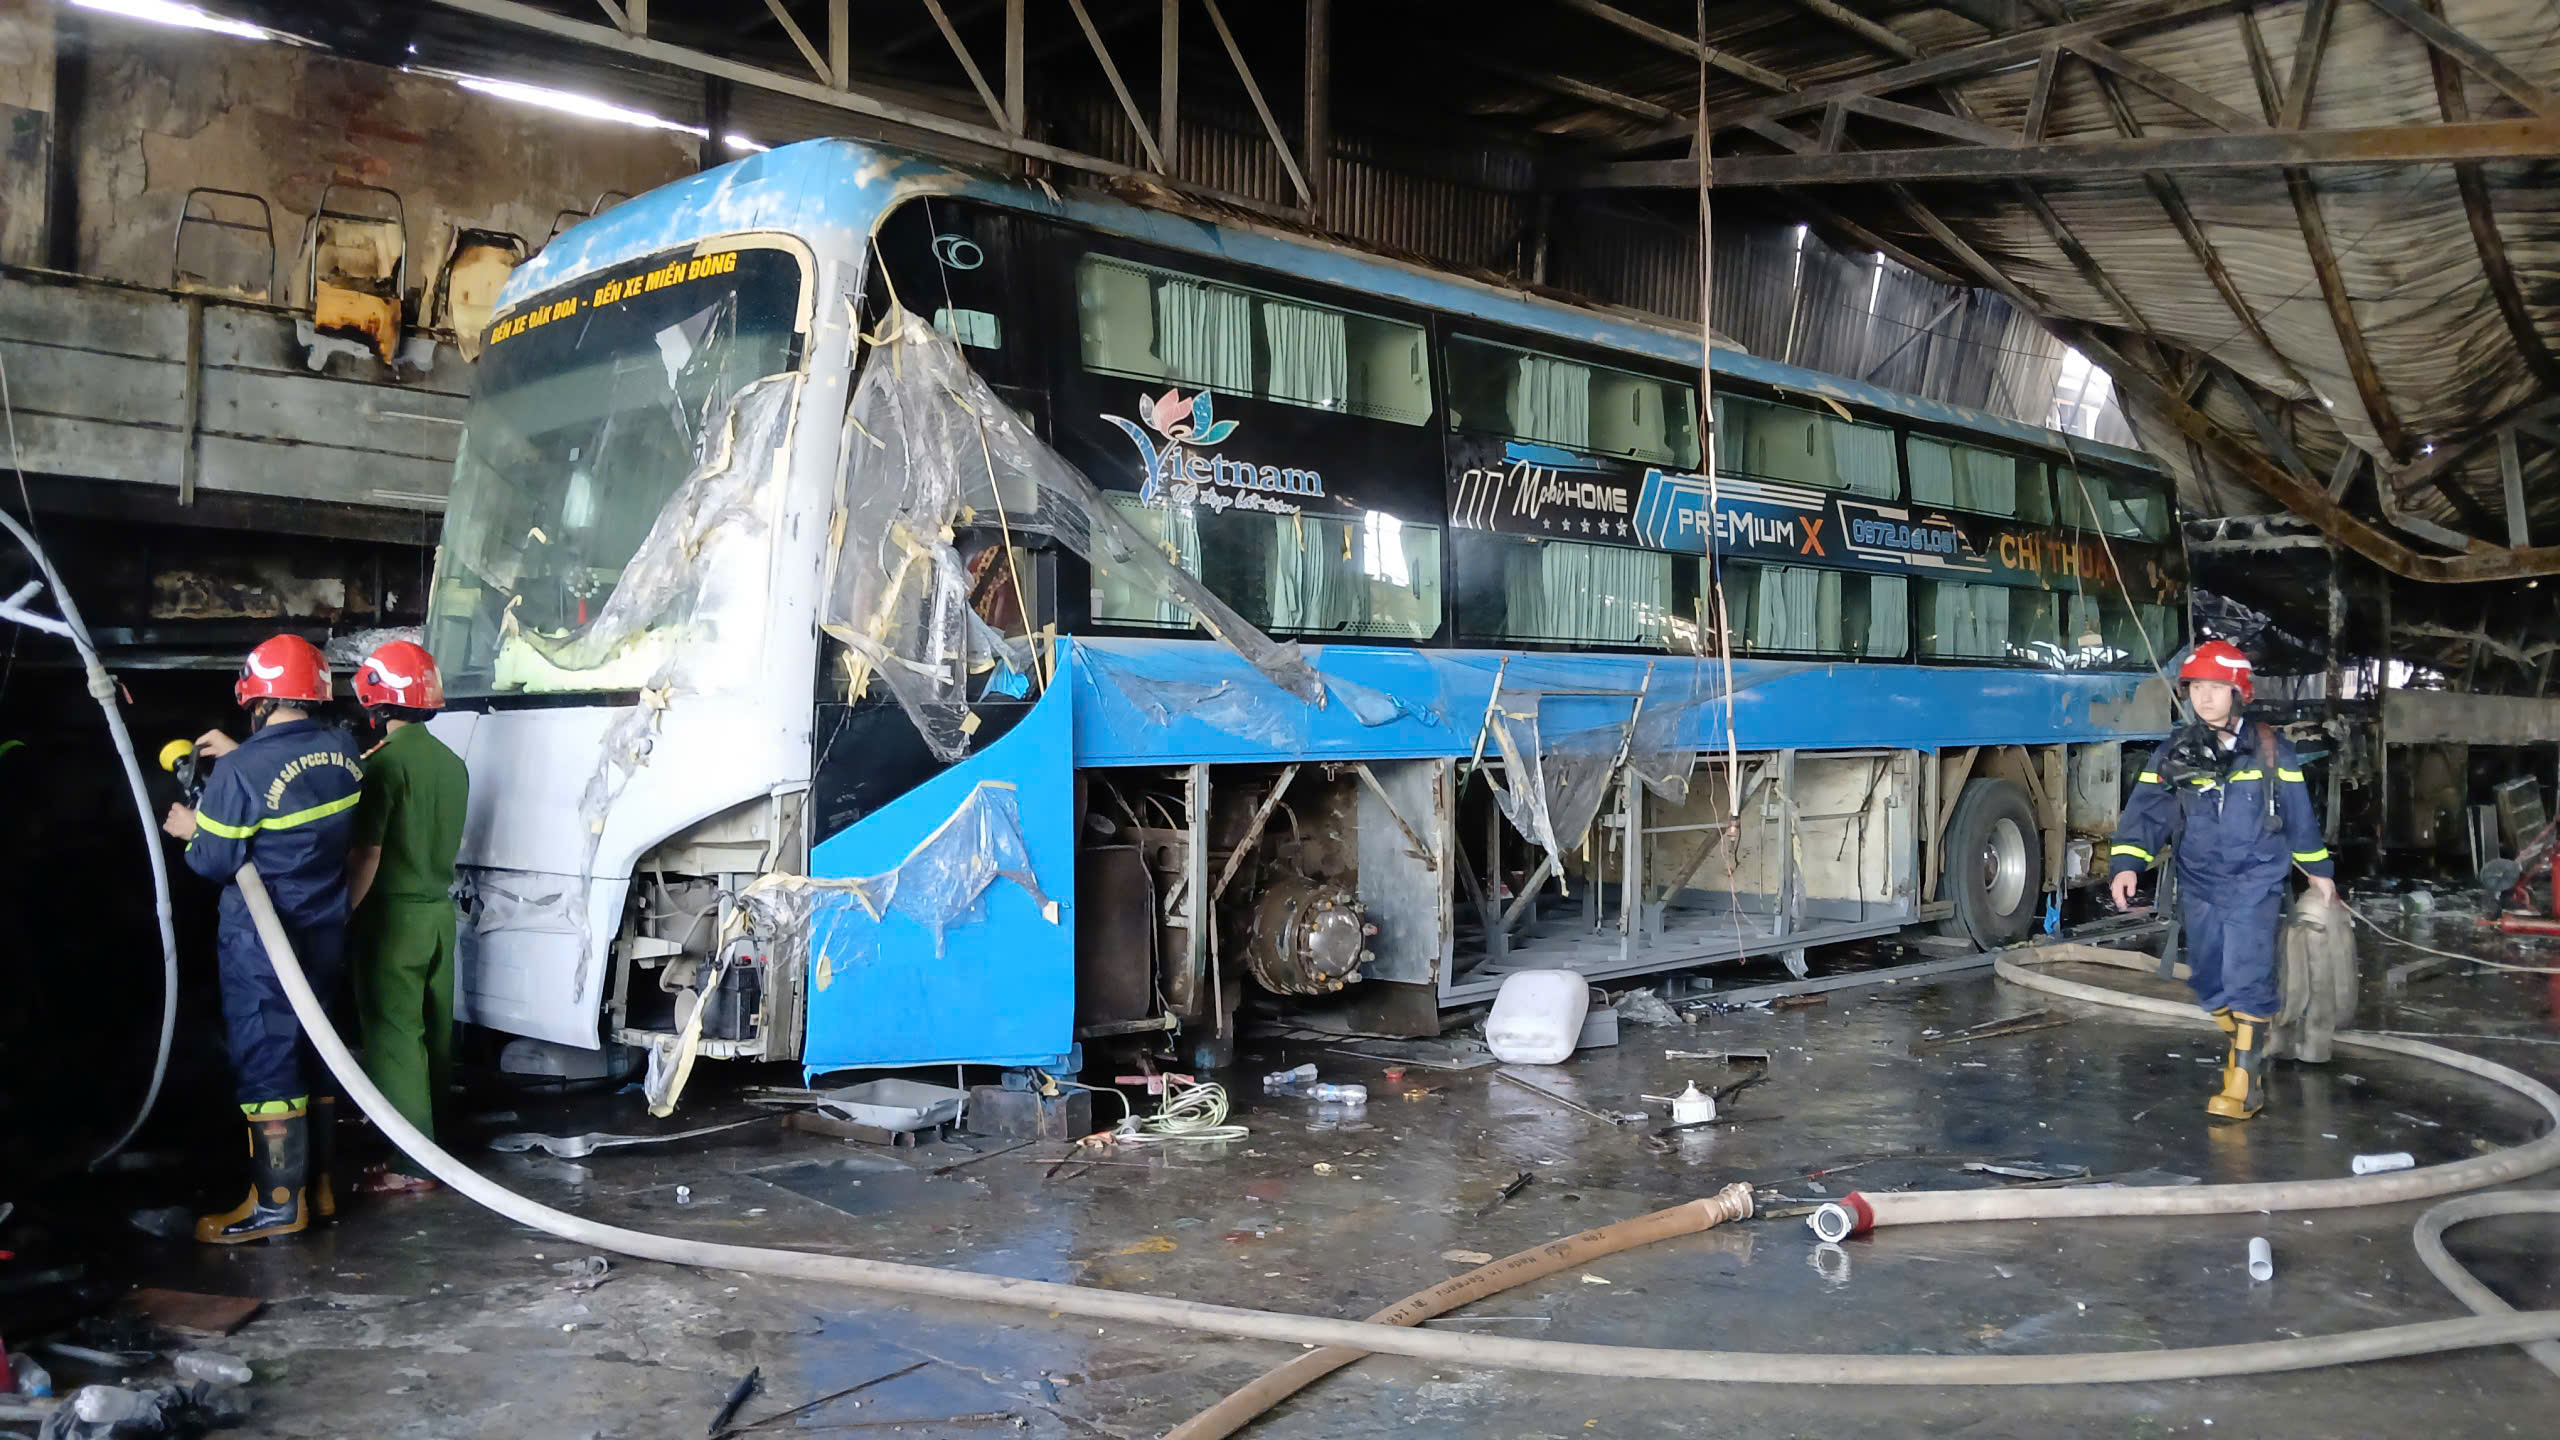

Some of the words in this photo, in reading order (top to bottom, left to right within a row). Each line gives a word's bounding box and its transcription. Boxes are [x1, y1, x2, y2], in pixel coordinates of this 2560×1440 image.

[511, 314, 529, 336] XE
[593, 278, 623, 308] BẾN
[623, 275, 644, 299] XE
[644, 260, 688, 292] MIỀN
[688, 251, 738, 281] ĐÔNG
[1100, 413, 1325, 508] Vietnam
[1507, 459, 1628, 520] MobiHOME
[1678, 507, 1795, 549] PREMIUM
[1799, 516, 1826, 557] X
[300, 752, 328, 769] PCCC
